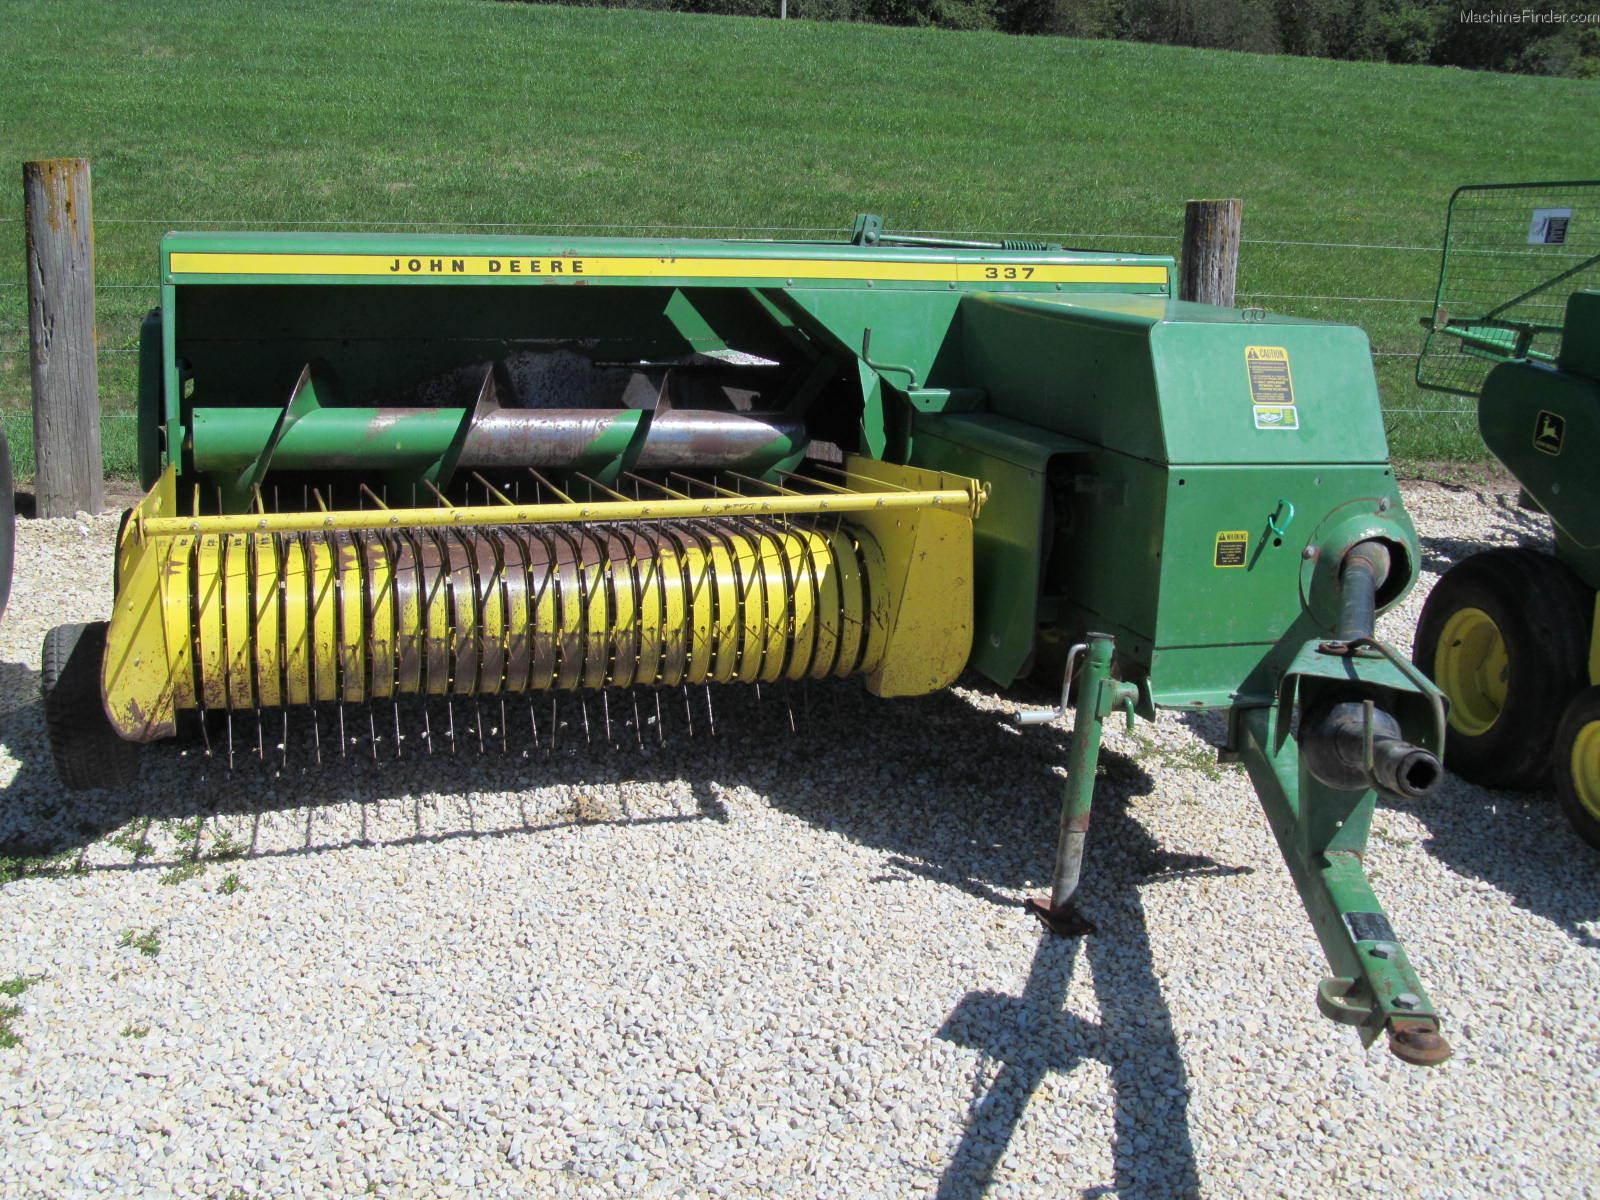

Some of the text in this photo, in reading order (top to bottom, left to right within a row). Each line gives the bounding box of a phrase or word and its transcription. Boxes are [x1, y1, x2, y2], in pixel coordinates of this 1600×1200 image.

[390, 258, 584, 273] JOHN DEERE
[985, 267, 1035, 280] 337
[1259, 348, 1285, 359] CAUTION
